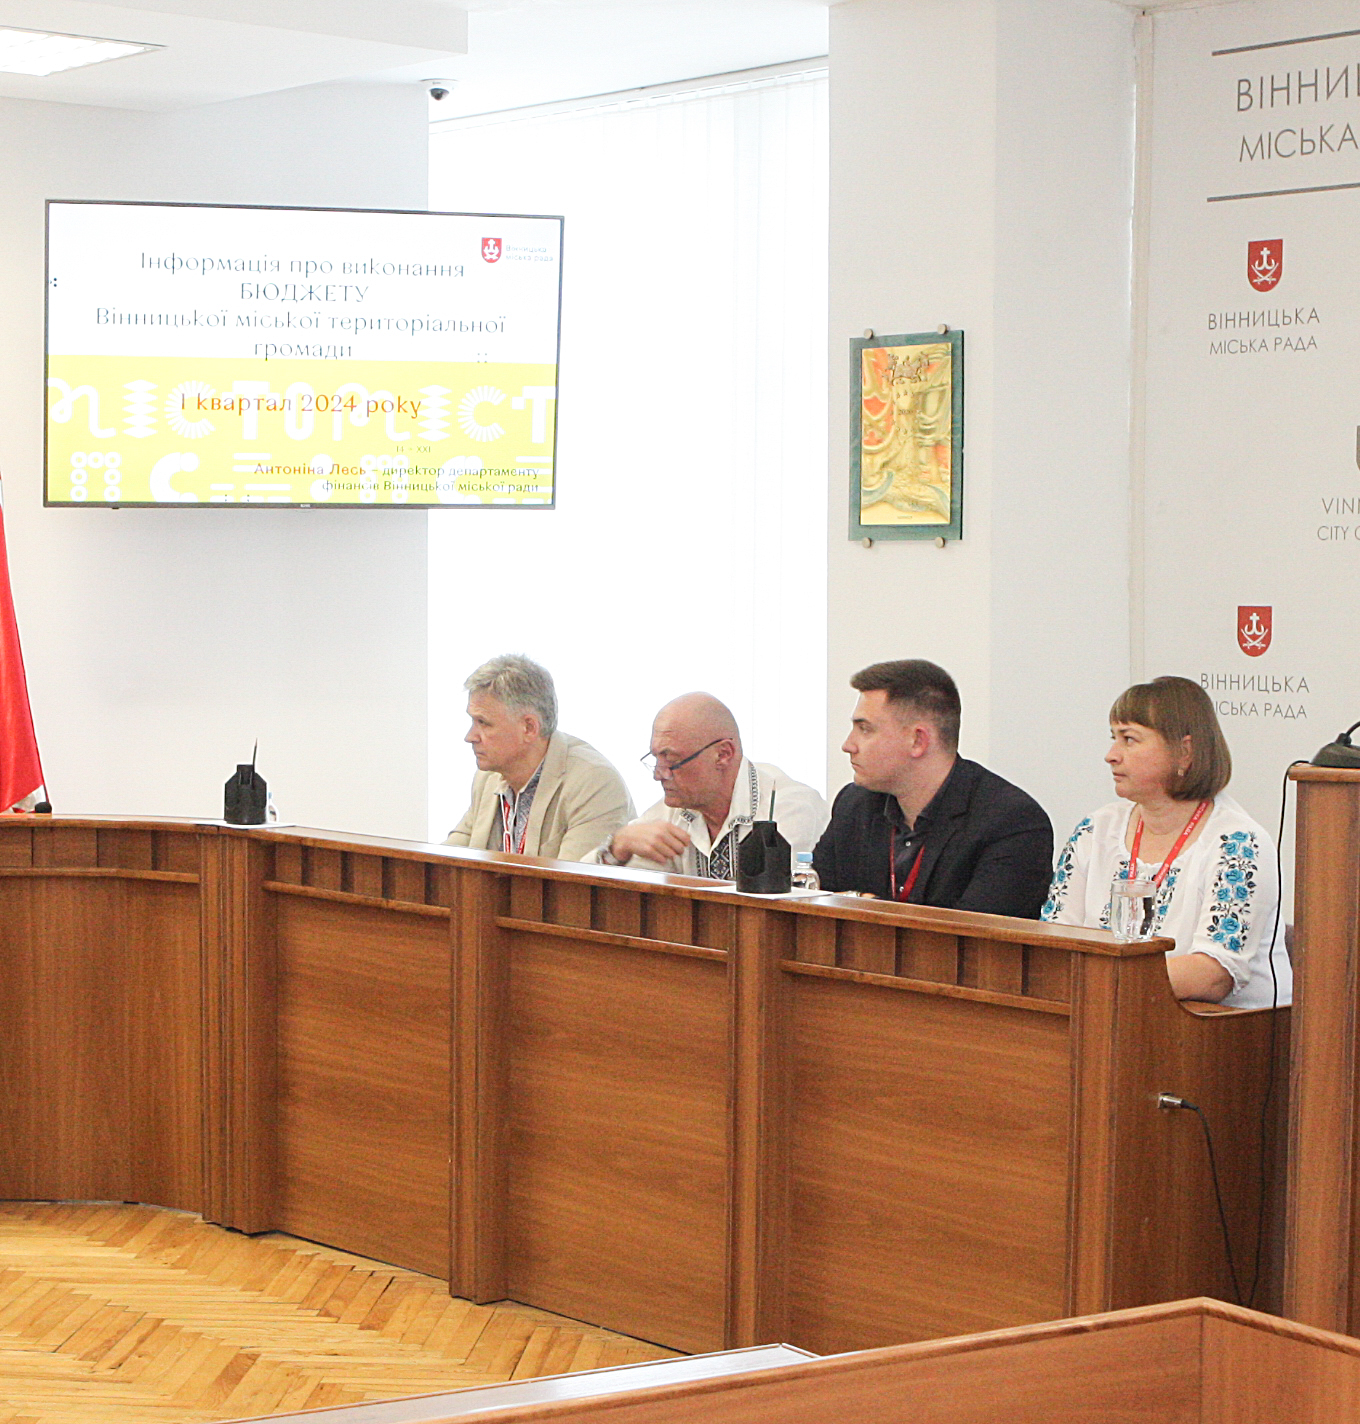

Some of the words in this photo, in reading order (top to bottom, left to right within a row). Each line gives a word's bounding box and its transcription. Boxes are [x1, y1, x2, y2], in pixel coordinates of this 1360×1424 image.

[1238, 122, 1359, 163] МІСЬКА
[140, 252, 280, 276] Інформація
[290, 259, 334, 278] про
[342, 258, 466, 278] виконання
[240, 282, 369, 302] БЮДЖЕТУ
[96, 307, 228, 328] Вінницької
[236, 310, 320, 330] міської
[328, 313, 508, 336] територіальної
[1208, 307, 1321, 331] ВІННИЦЬКА
[254, 342, 353, 361] громади
[1209, 338, 1269, 355] МІСЬКА
[1273, 335, 1318, 352] РАДА
[196, 392, 293, 414] квартал
[301, 394, 358, 414] 2024
[365, 393, 423, 419] року
[253, 463, 324, 476] Антоніна
[328, 464, 366, 476] Лесь
[382, 465, 446, 479] директор
[448, 466, 540, 480] департаменту
[383, 480, 456, 492] Вінницької
[458, 480, 506, 492] міської
[508, 482, 540, 494] ради
[1316, 525, 1347, 541] CITY
[1200, 672, 1310, 694] ВІННИЦЬКА
[1215, 700, 1259, 717] ІСЬКА
[1263, 702, 1307, 720] РАДА
